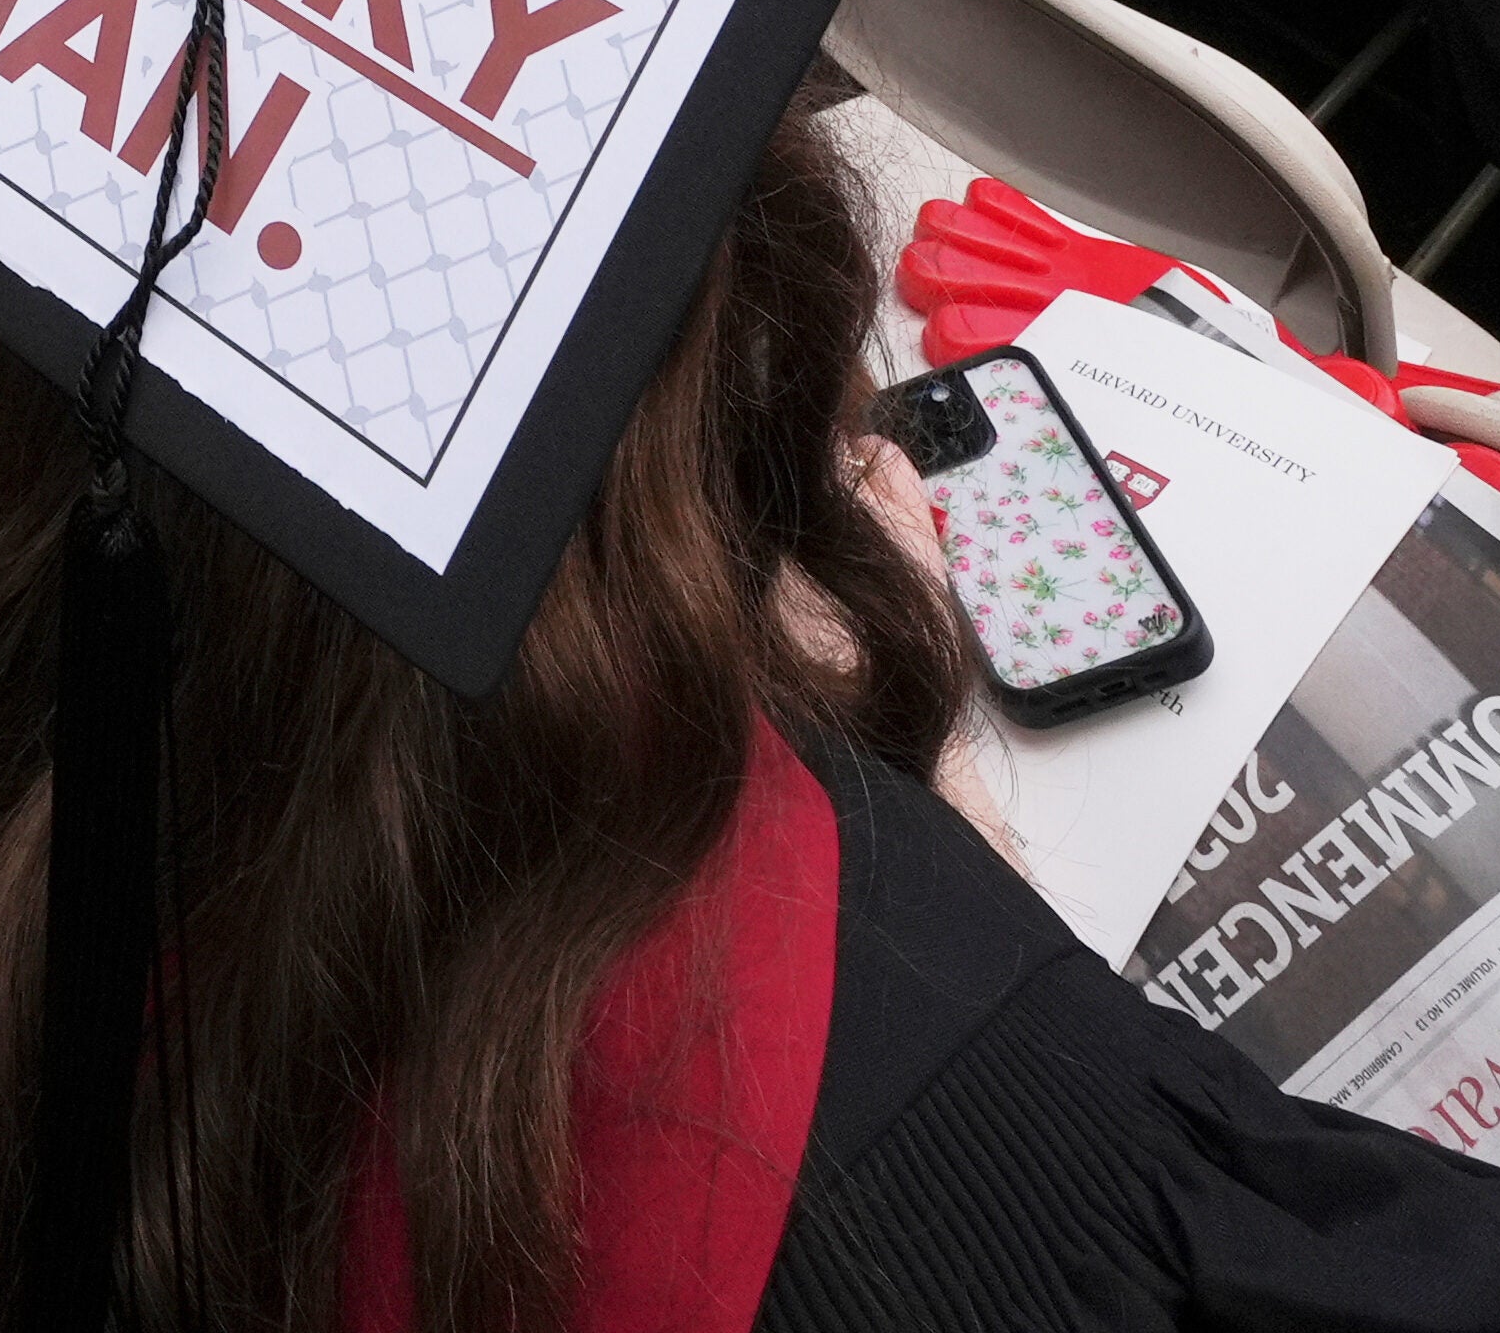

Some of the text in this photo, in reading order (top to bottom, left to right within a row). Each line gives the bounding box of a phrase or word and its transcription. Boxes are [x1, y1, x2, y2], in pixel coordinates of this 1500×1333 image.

[1069, 359, 1317, 485] HARVARD UNIVERSITY
[1460, 957, 1499, 993] VOLUME
[1413, 1016, 1431, 1035] 13
[1349, 1041, 1404, 1091] CAMBRIDGE,
